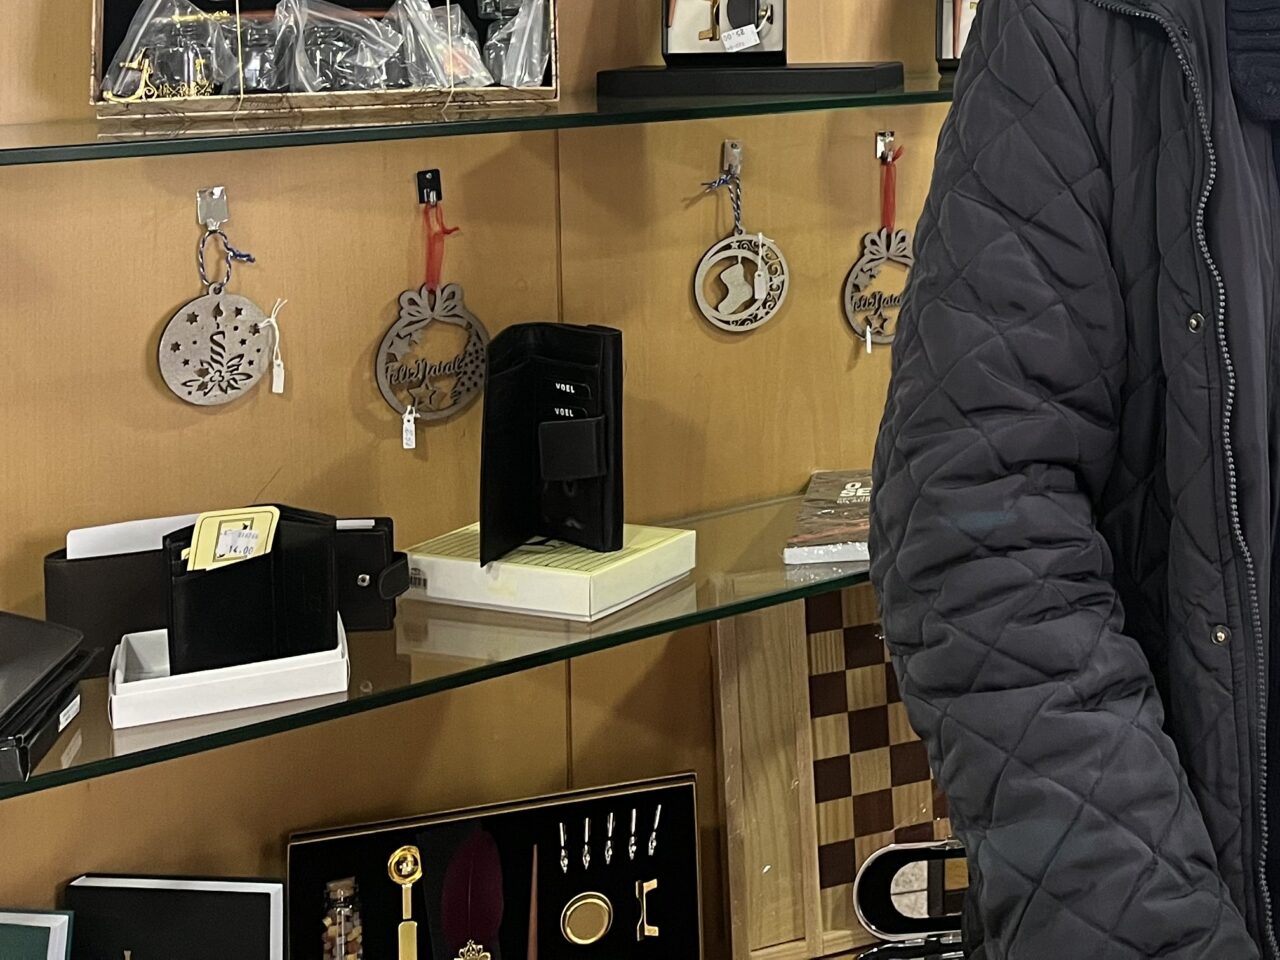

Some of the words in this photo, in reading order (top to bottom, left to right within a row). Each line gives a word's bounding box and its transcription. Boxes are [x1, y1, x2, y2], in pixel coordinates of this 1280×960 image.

[555, 382, 576, 394] VOEL
[554, 407, 574, 418] VOEL
[845, 481, 862, 490] O
[840, 488, 872, 497] SE
